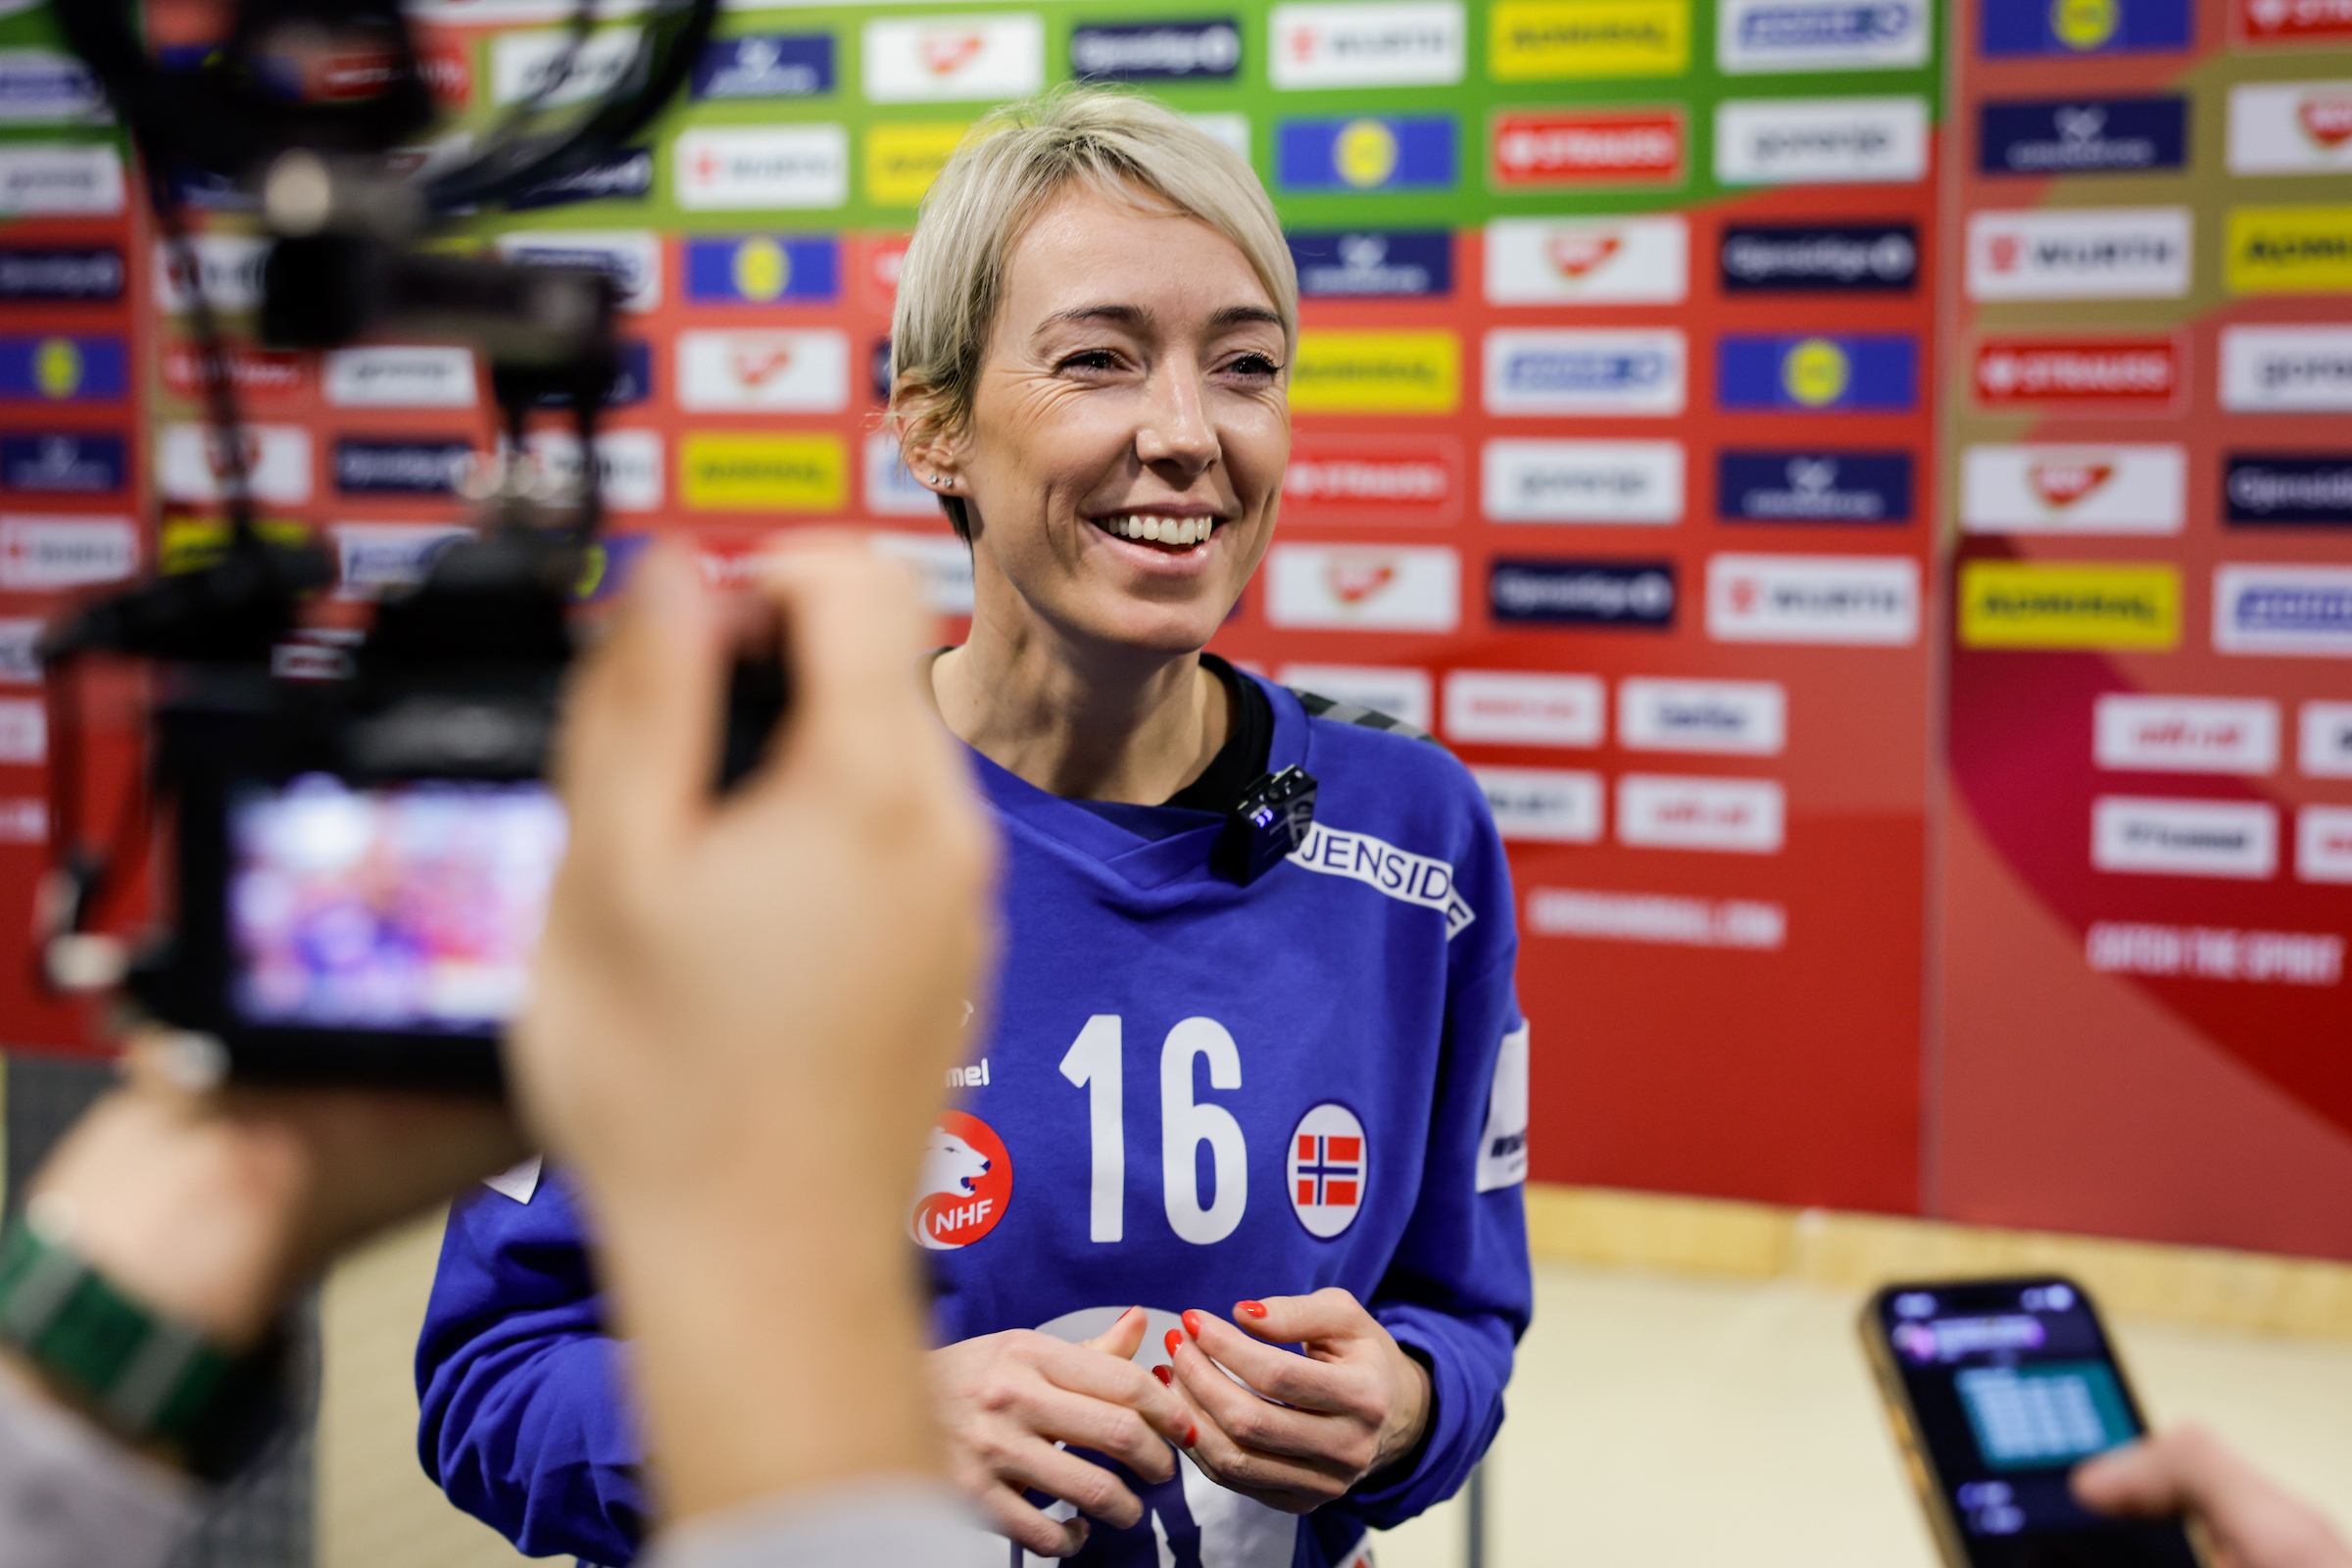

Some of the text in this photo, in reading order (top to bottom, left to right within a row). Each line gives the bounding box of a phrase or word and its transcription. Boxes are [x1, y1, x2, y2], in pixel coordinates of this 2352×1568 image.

[945, 1057, 990, 1088] mel
[1058, 1013, 1249, 1246] 16
[935, 1198, 994, 1235] NHF
